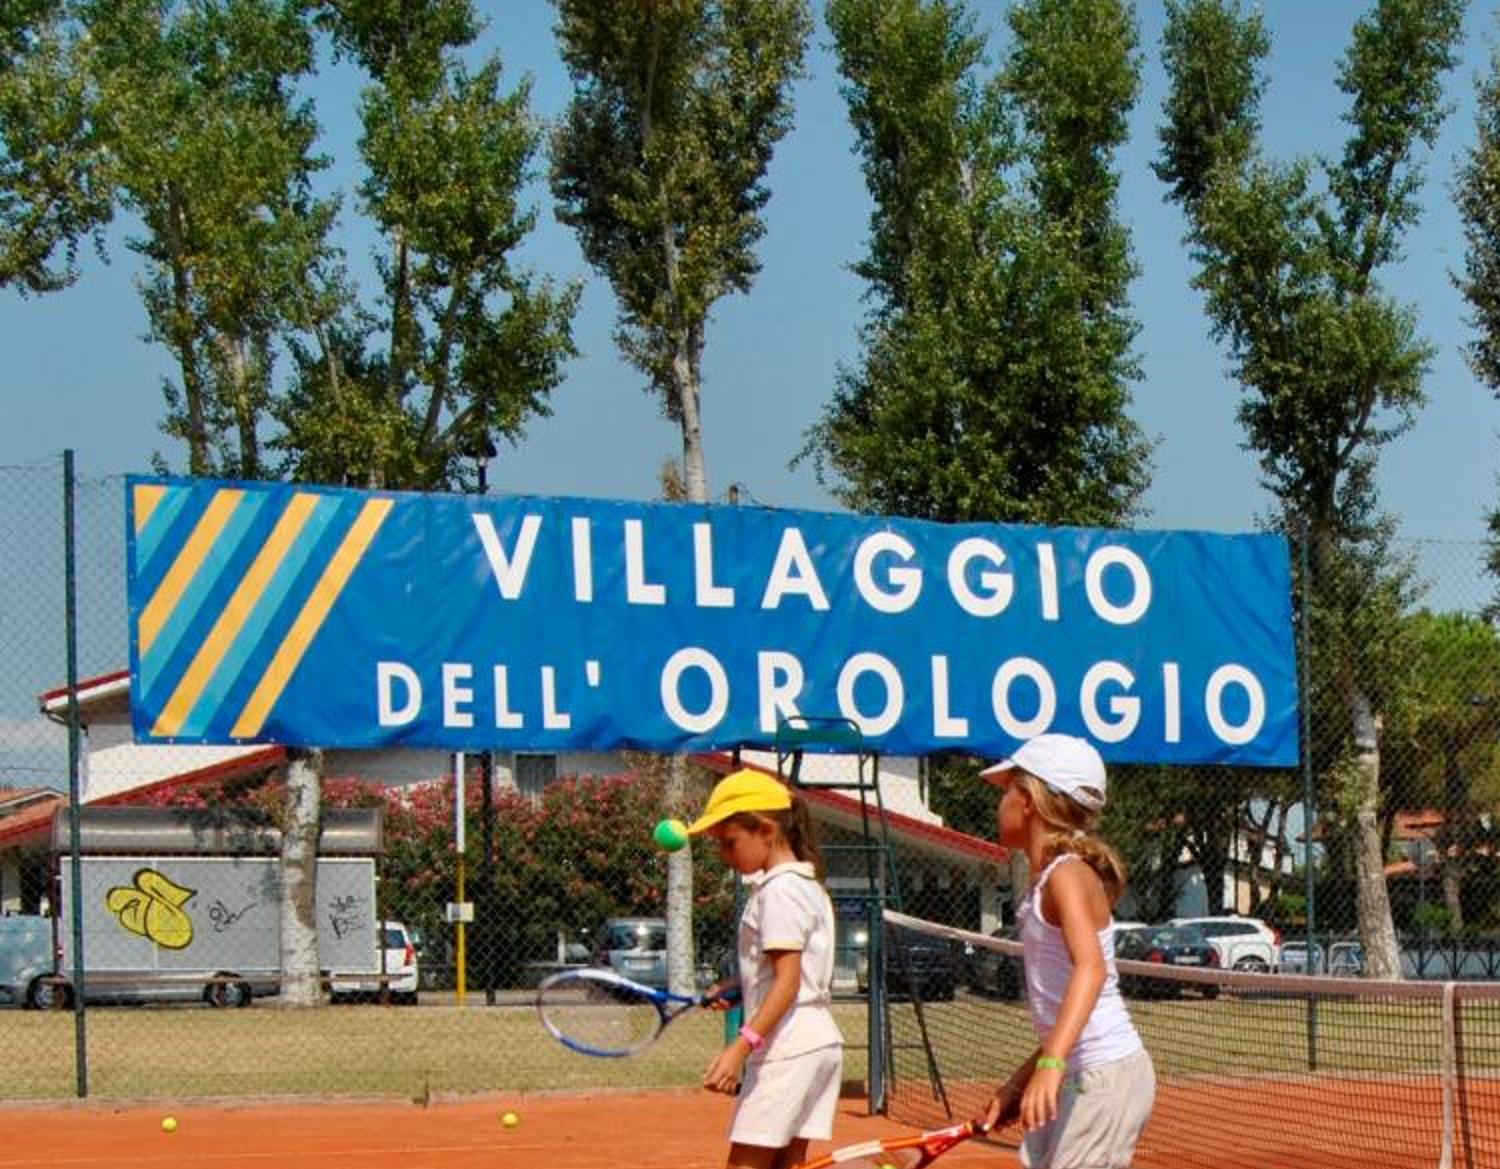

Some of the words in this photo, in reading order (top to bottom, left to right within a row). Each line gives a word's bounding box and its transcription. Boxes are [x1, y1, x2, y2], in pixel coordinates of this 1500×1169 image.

[472, 513, 1152, 625] VILLAGGIO
[377, 660, 600, 729] DELL'
[660, 647, 1266, 745] OROLOGIO
